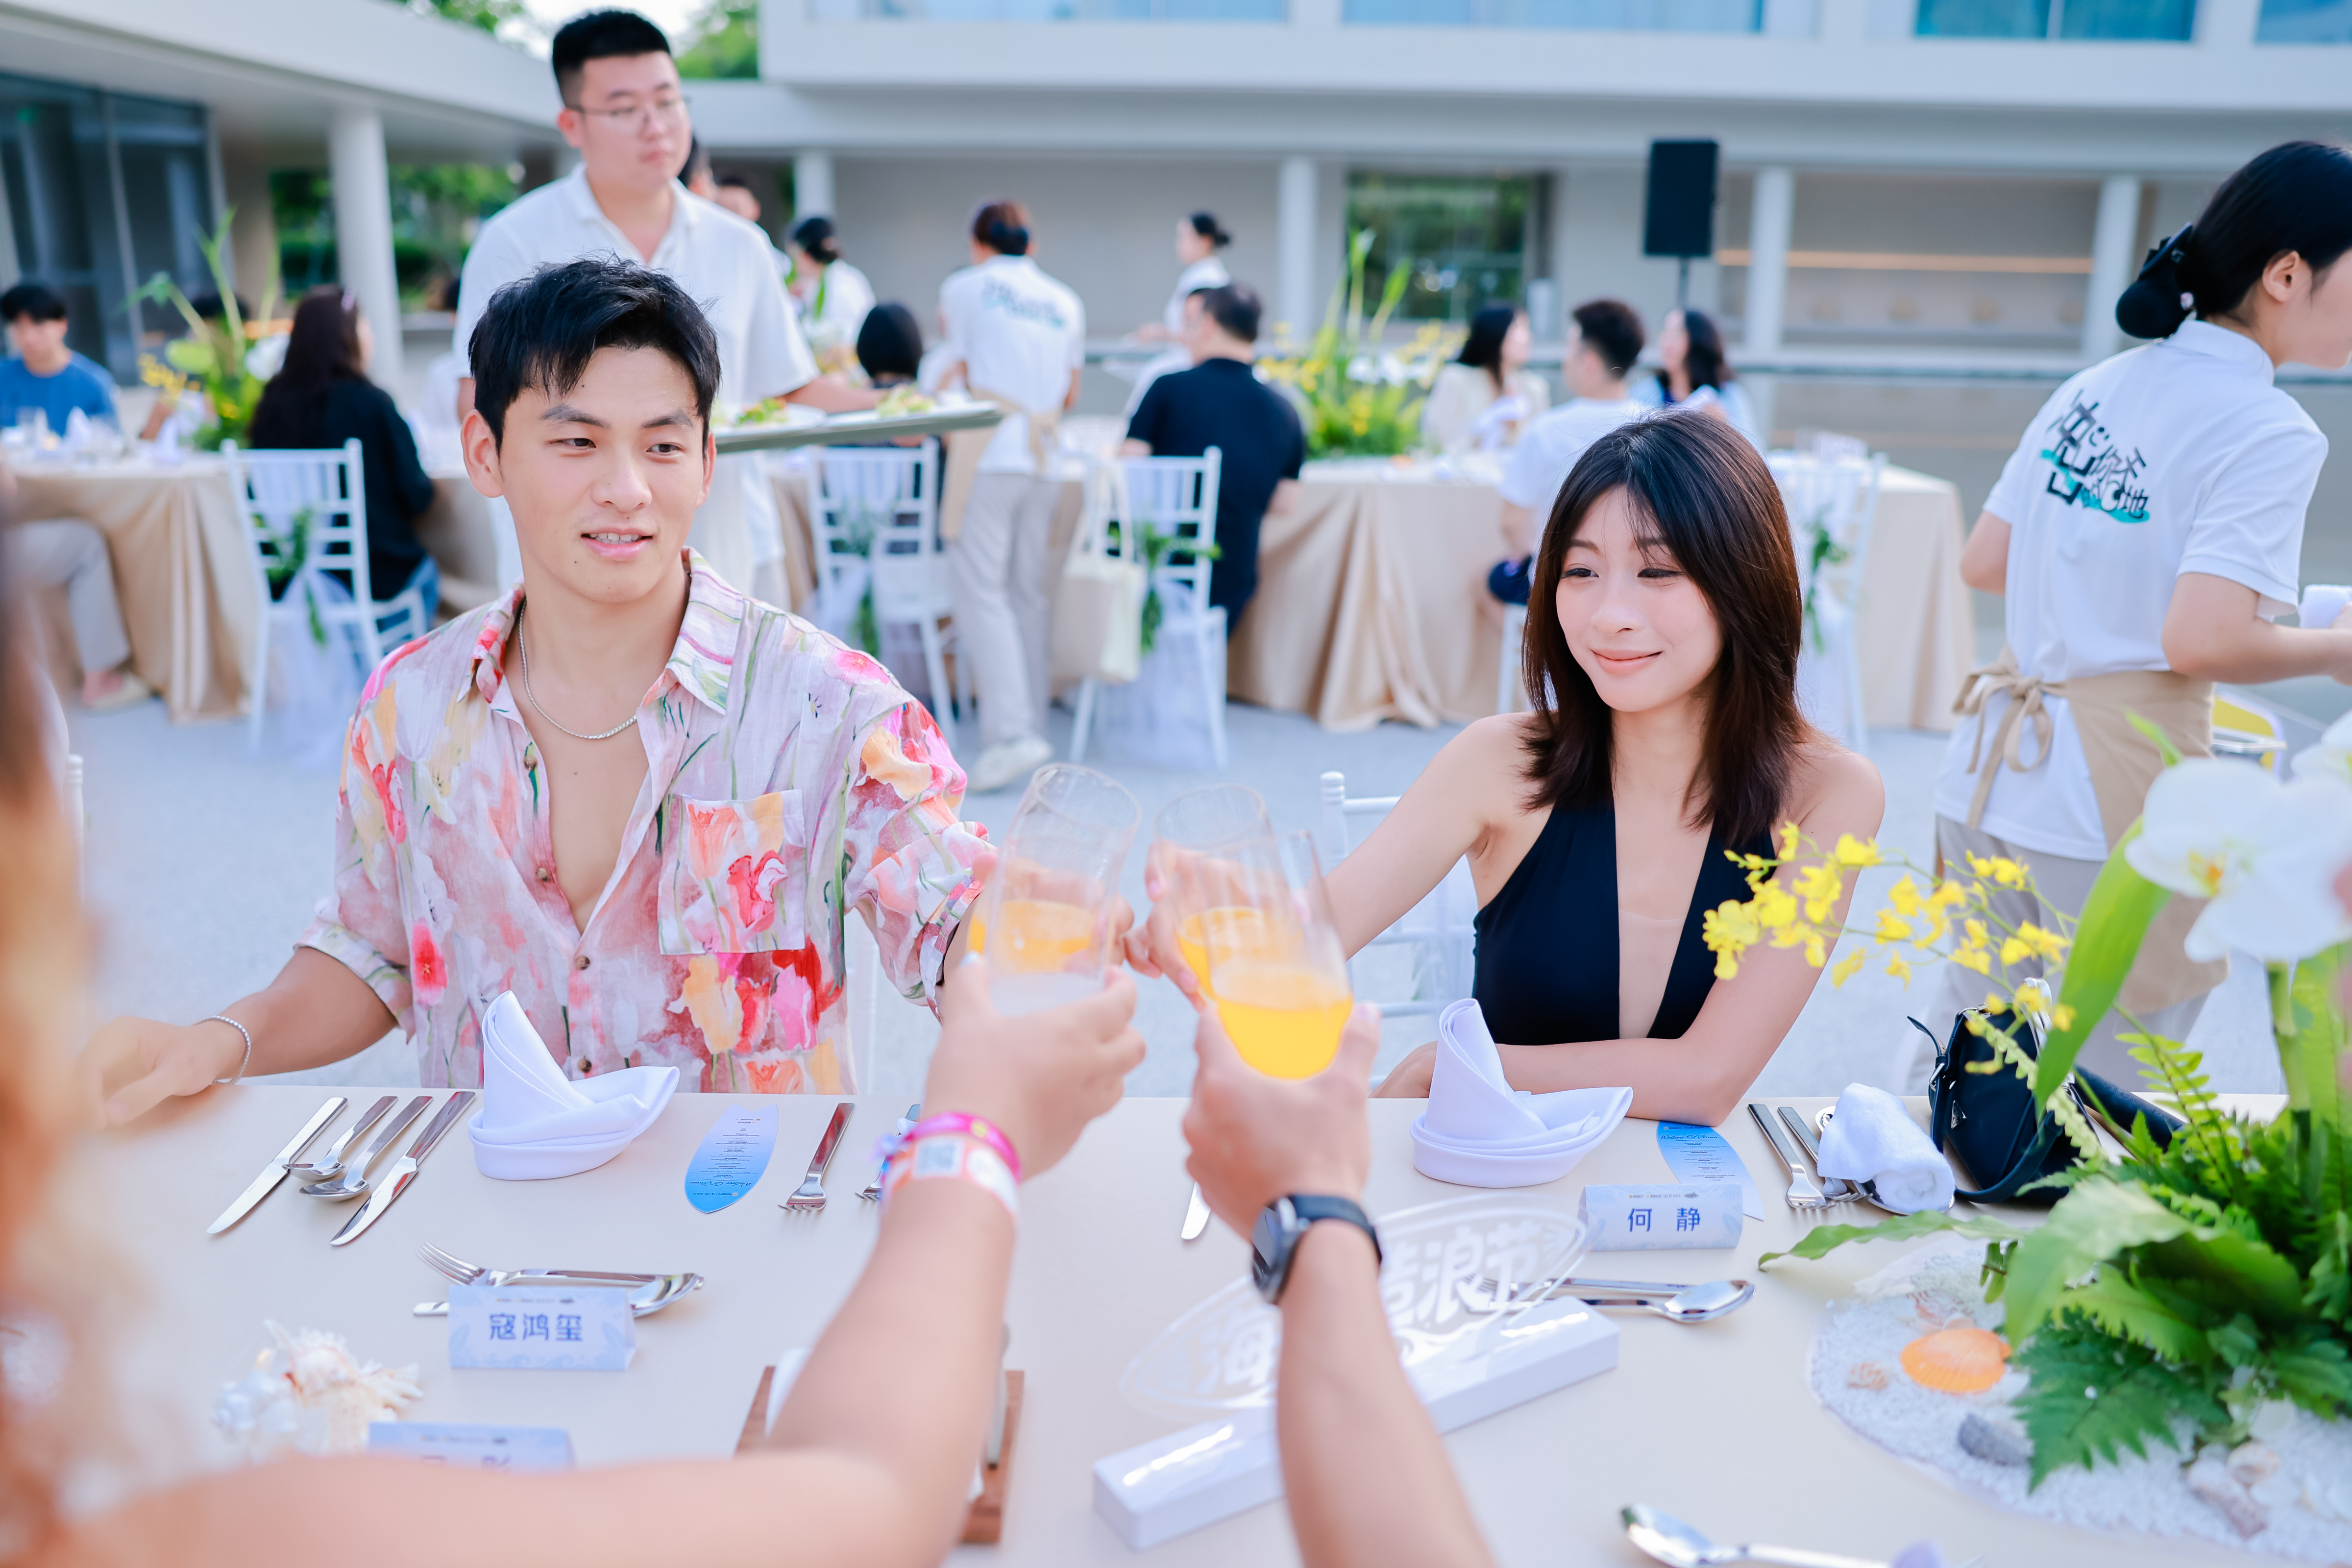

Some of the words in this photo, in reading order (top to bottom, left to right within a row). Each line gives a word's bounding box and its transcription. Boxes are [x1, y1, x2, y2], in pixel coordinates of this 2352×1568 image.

[1627, 1207, 1700, 1232] 何静
[490, 1313, 582, 1341] 寇鸿玺
